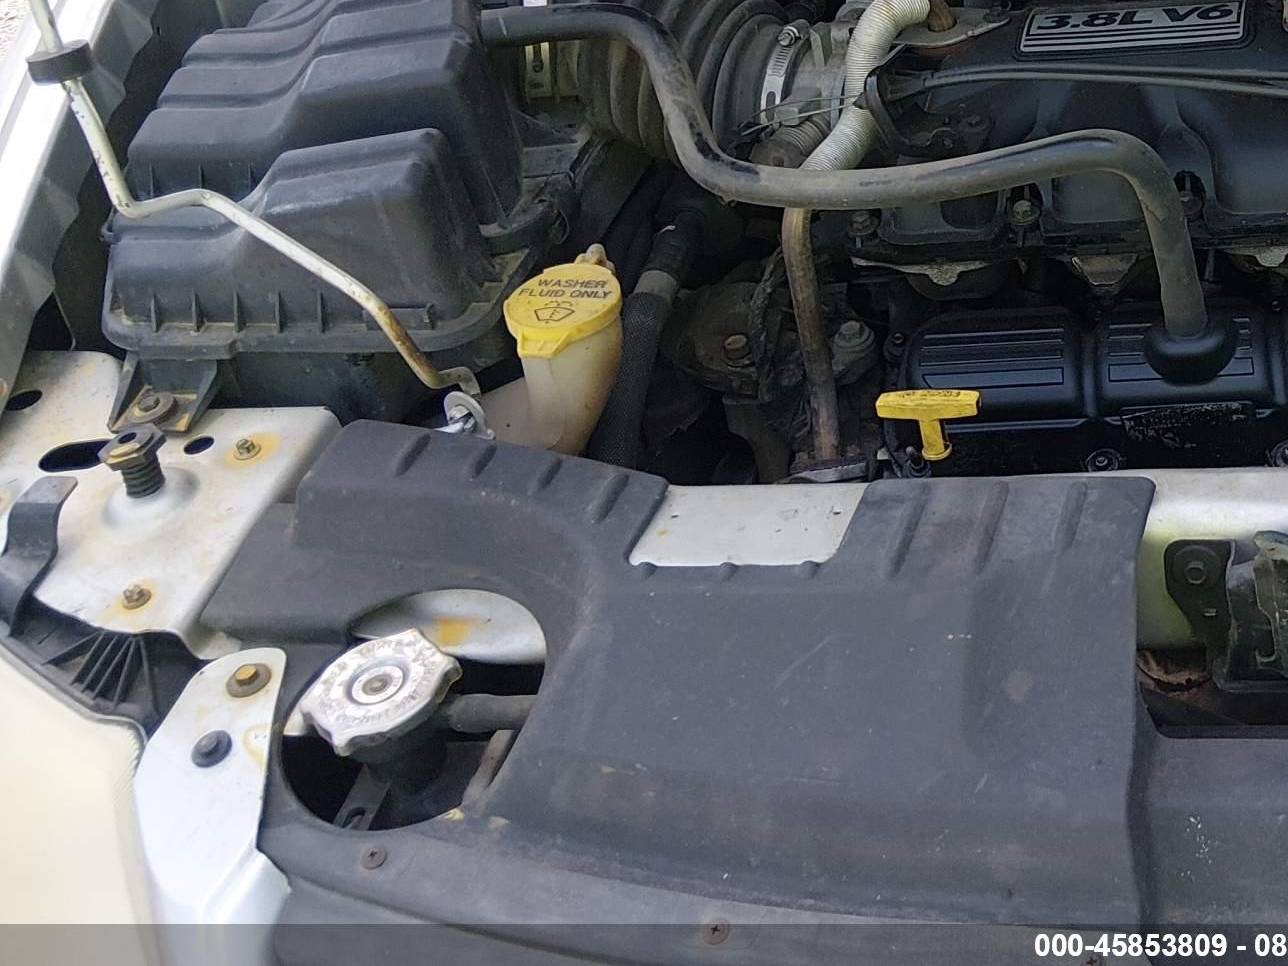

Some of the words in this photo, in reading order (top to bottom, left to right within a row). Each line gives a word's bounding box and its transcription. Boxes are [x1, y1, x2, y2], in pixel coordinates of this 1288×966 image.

[1035, 10, 1152, 31] 3.8L
[1160, 4, 1234, 23] V6
[537, 279, 608, 288] WASHER
[518, 289, 566, 298] FLUID
[569, 290, 613, 299] ONLY
